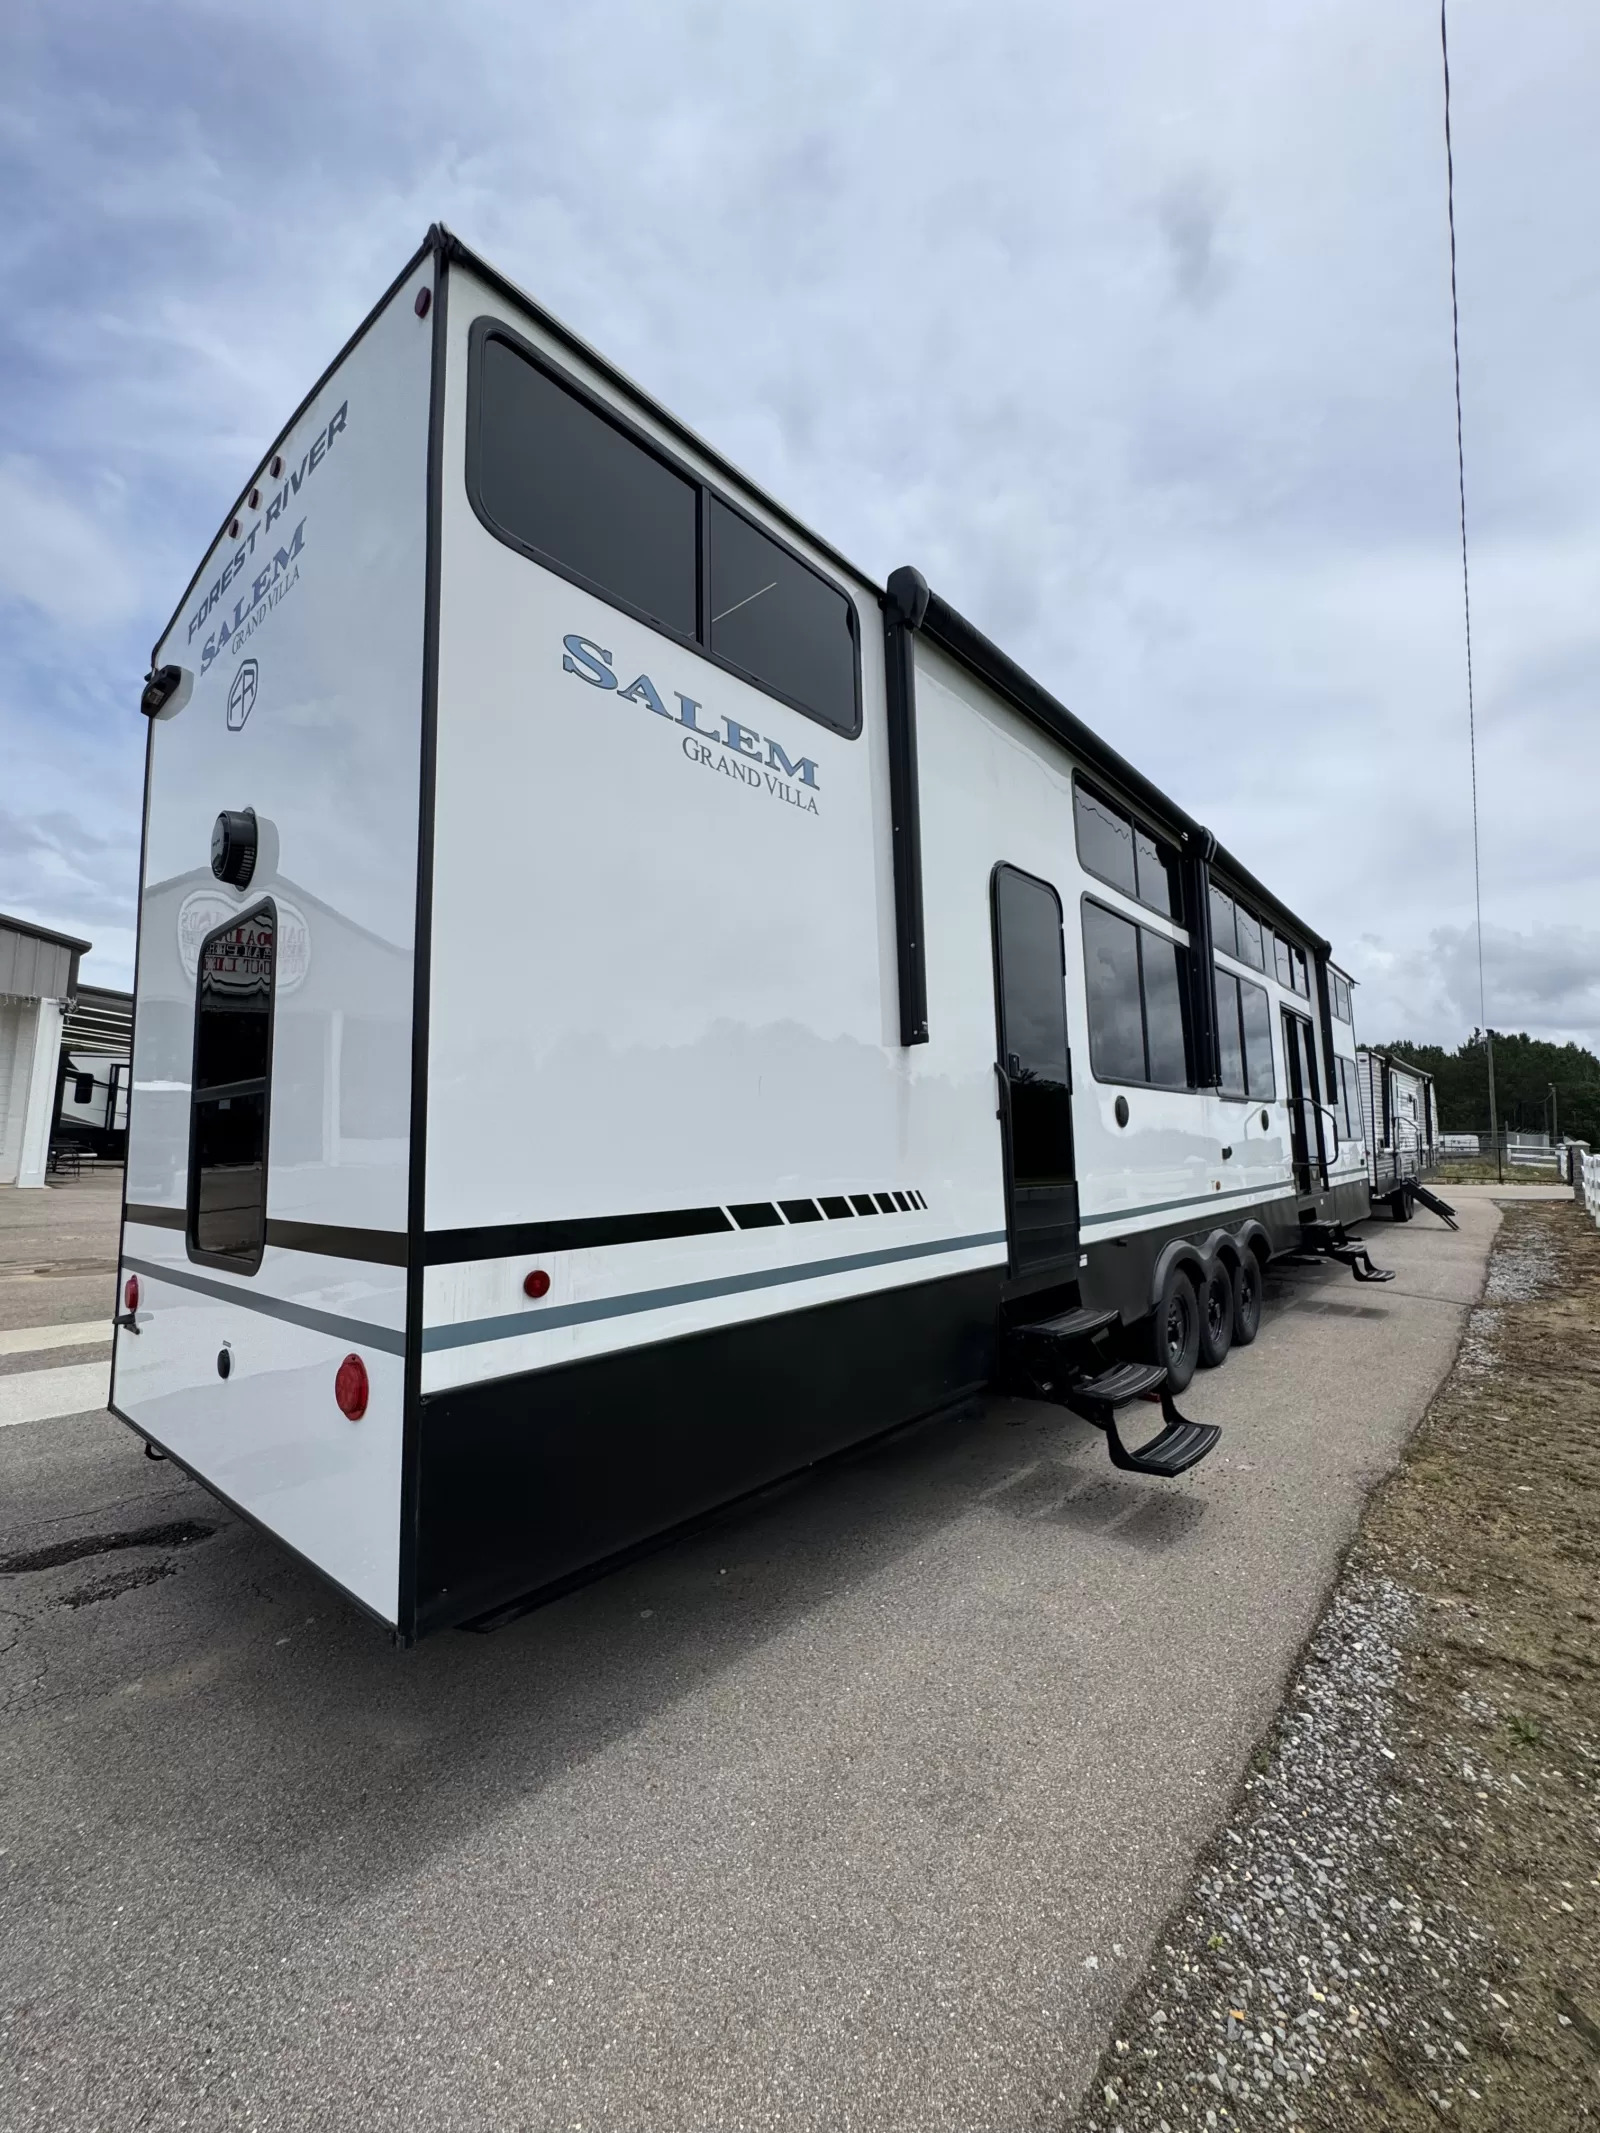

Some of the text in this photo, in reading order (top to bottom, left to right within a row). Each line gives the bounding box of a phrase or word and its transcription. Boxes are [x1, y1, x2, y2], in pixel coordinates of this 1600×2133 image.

[188, 399, 348, 646] FOREST RIVER
[200, 516, 308, 677] SALEM
[231, 563, 300, 655] GRAND VILLA
[562, 634, 820, 791] SALEM
[682, 736, 820, 816] GRAND VILLA
